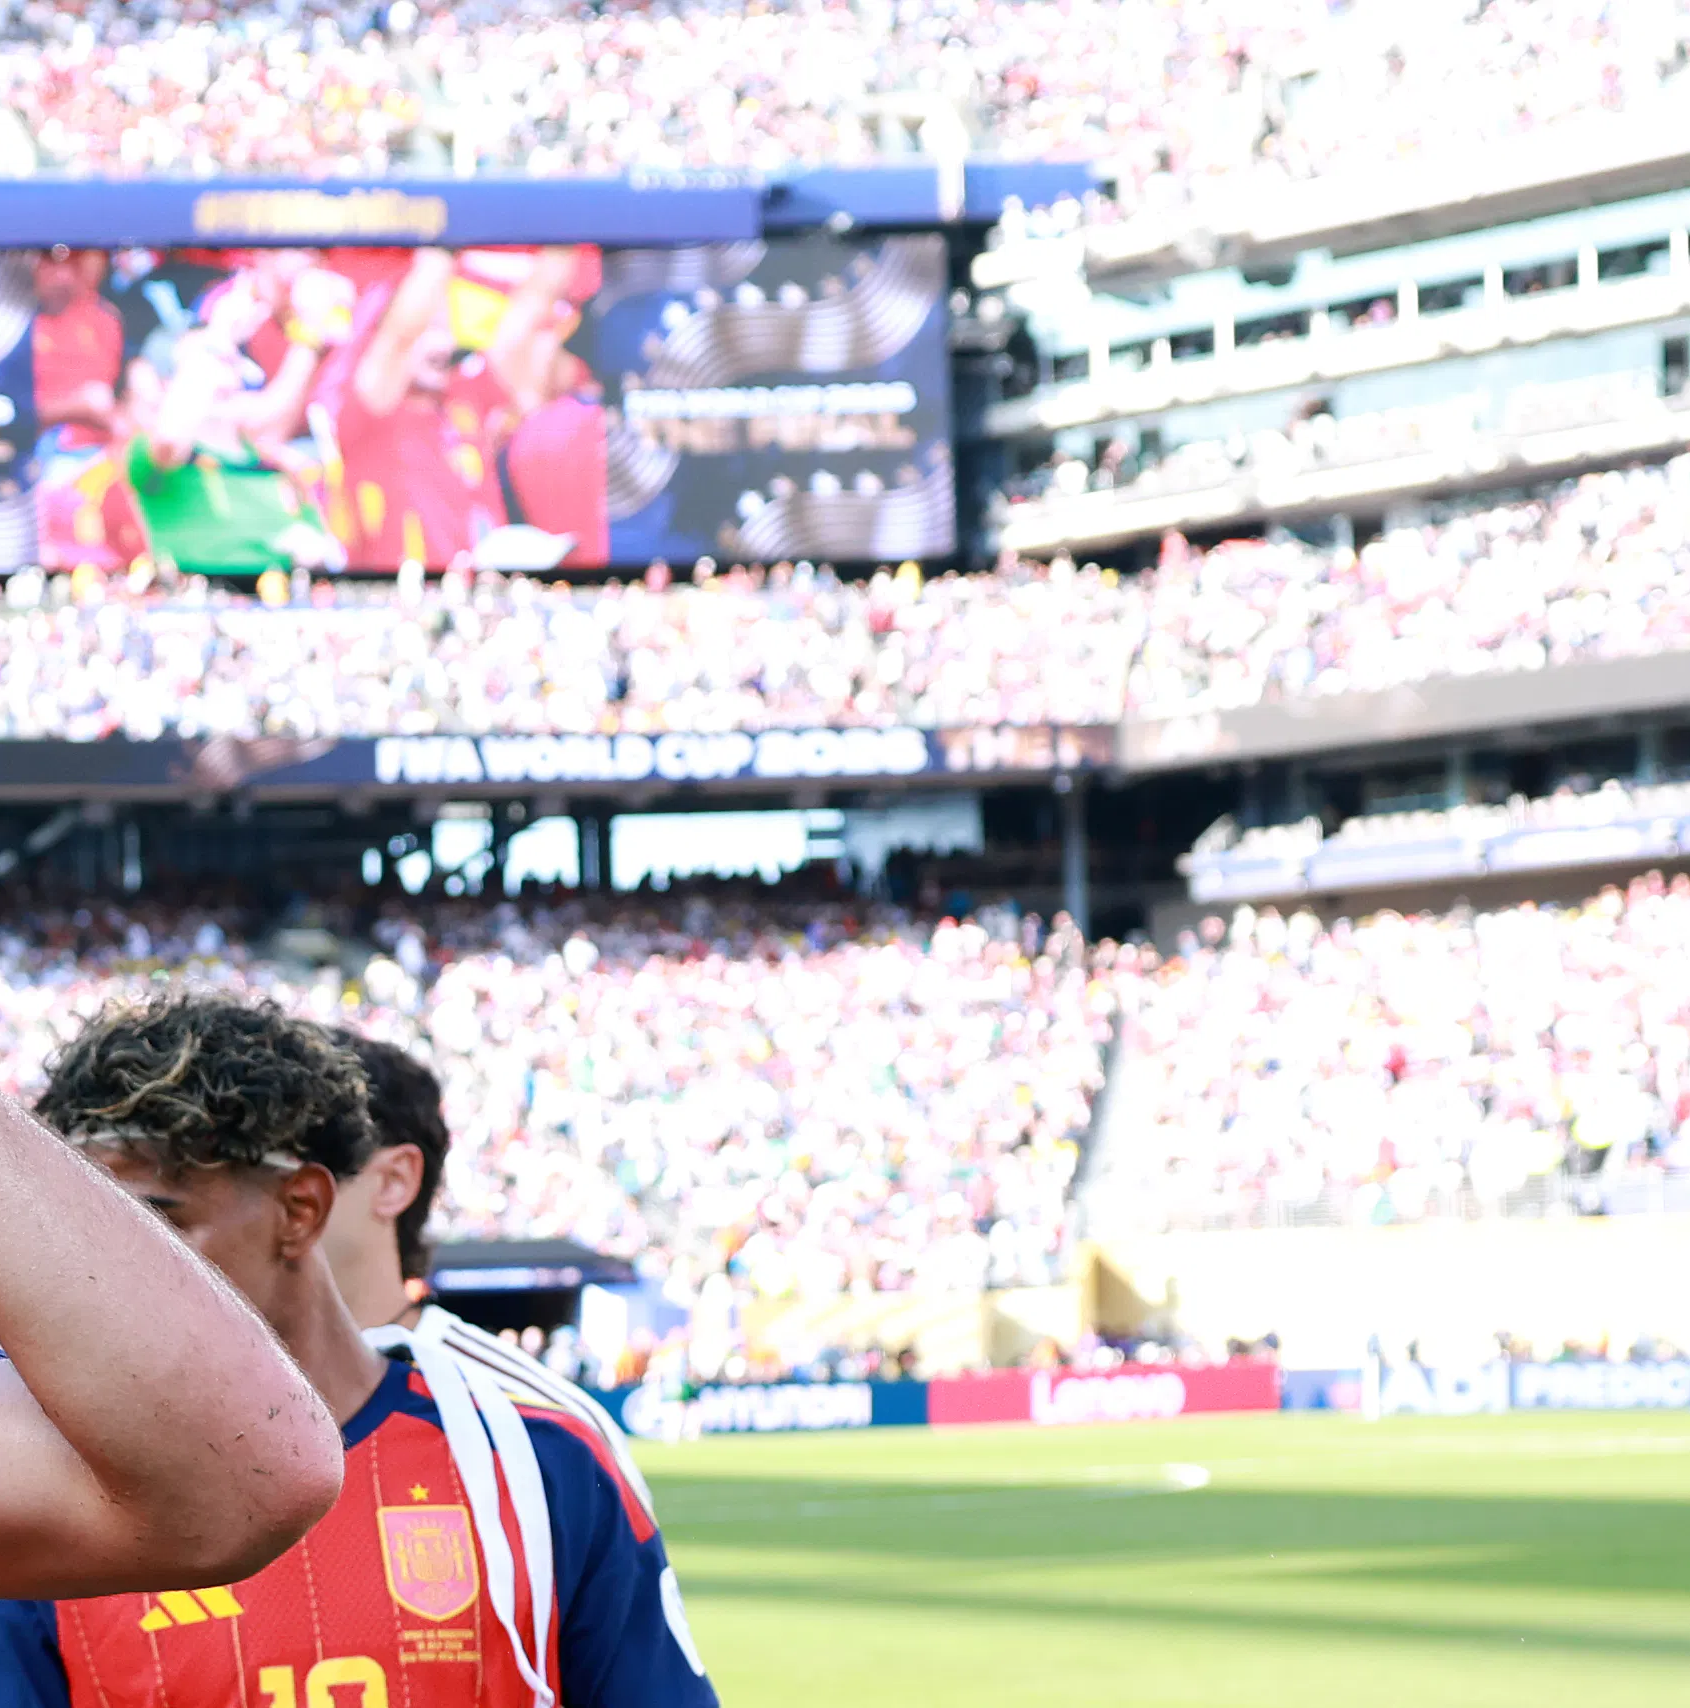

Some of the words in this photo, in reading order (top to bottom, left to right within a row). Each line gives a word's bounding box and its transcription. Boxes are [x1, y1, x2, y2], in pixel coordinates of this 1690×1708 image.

[374, 736, 485, 784] FIFA
[481, 734, 654, 781] WORLD
[655, 731, 753, 779] CUP
[755, 726, 927, 776] 2026
[1030, 1370, 1186, 1425] Lenovo
